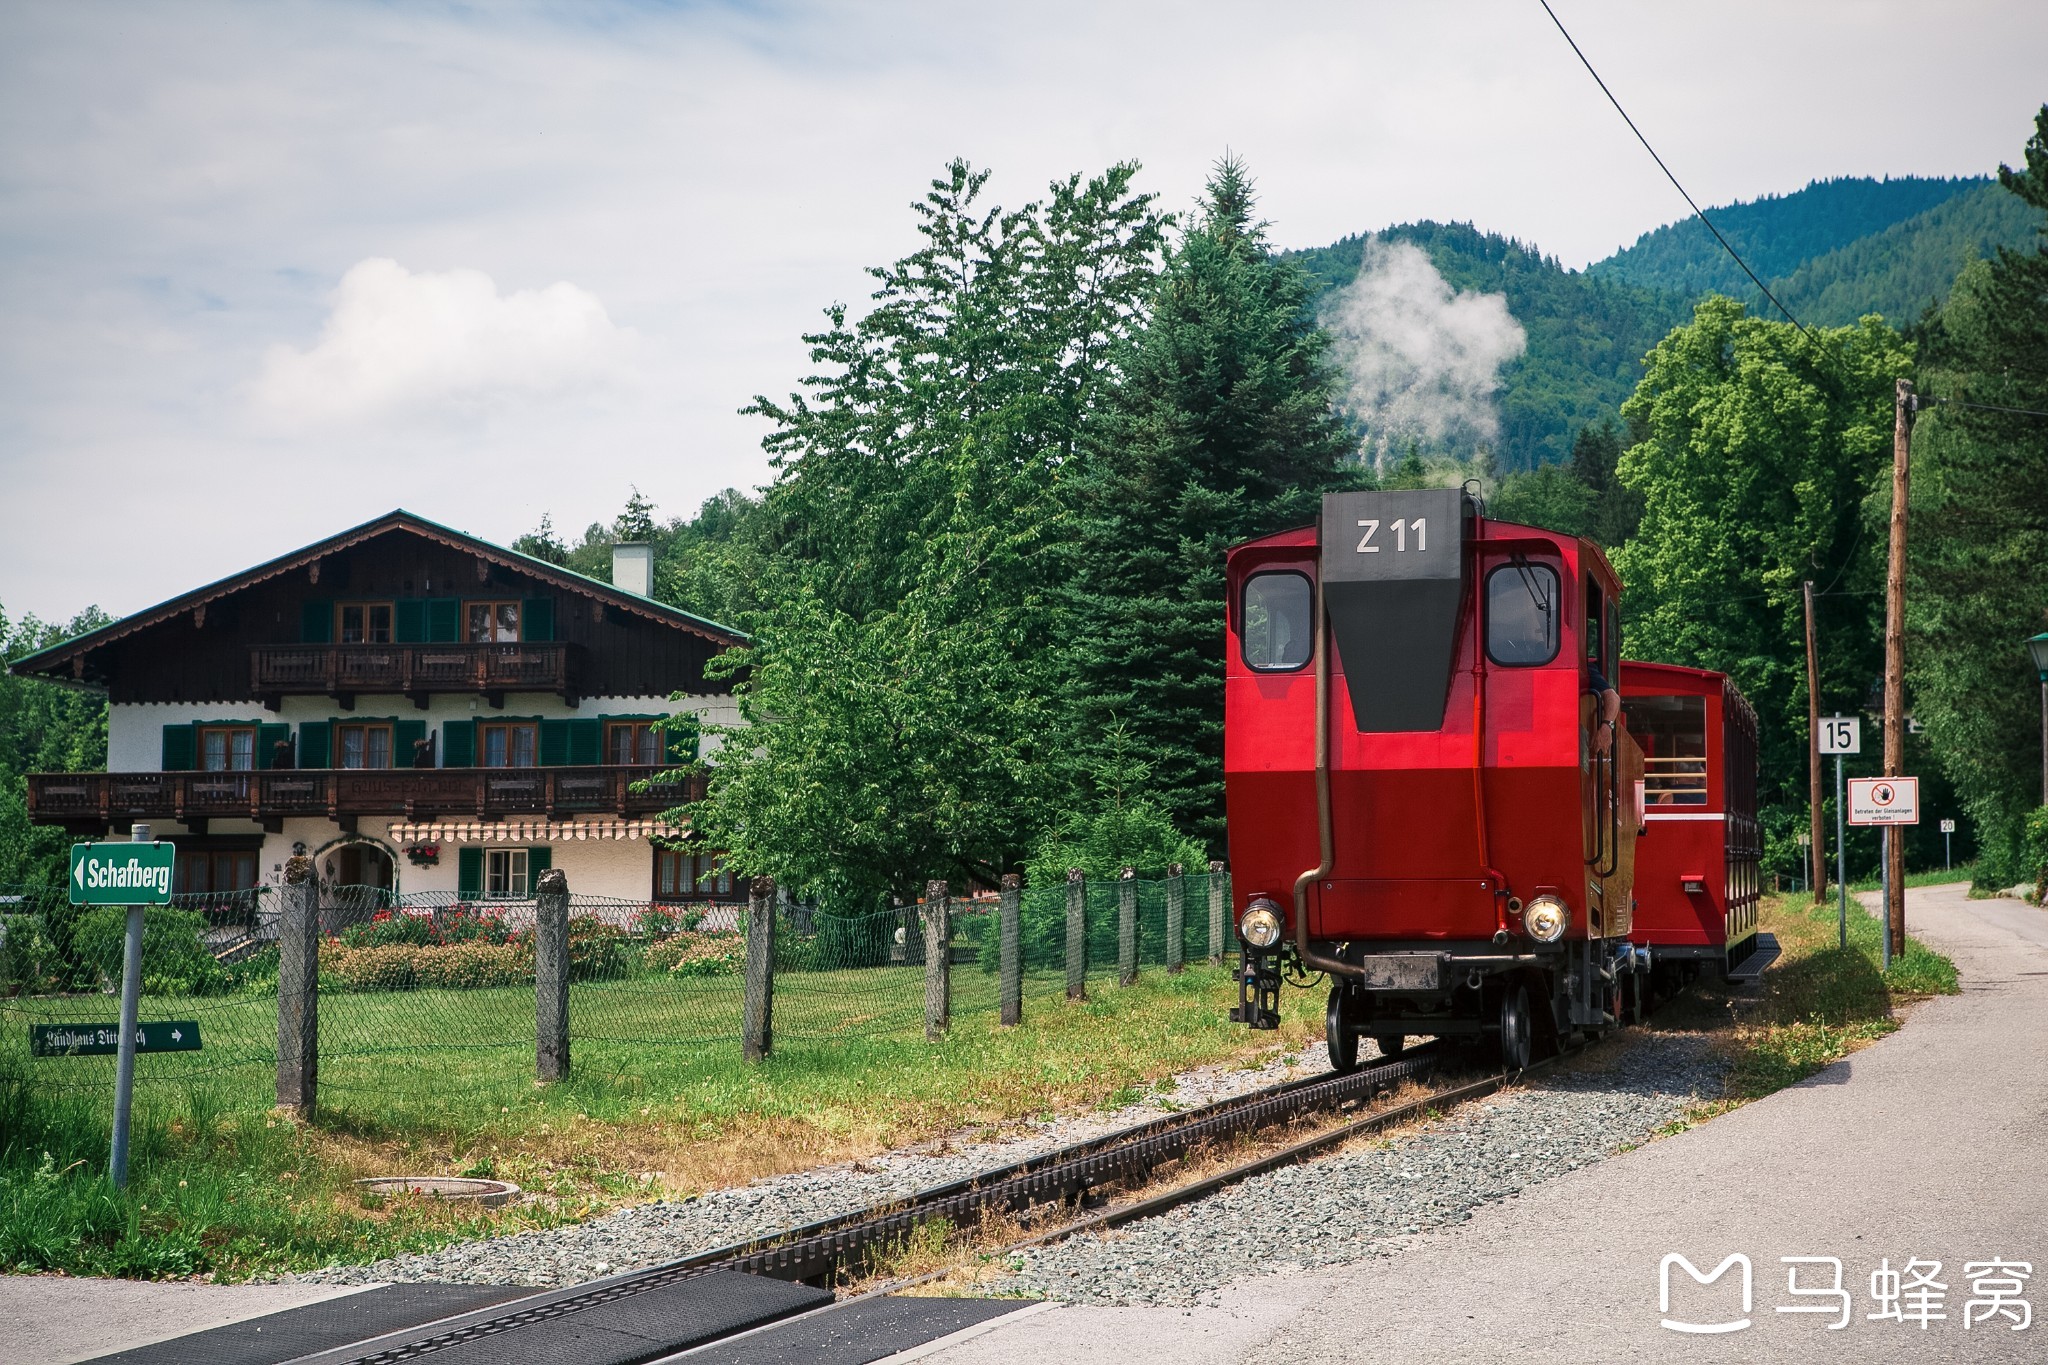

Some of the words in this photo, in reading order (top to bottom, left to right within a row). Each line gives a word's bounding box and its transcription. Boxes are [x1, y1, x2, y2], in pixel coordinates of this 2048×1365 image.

[1357, 519, 1380, 552] Z
[1389, 518, 1426, 551] 11
[1826, 722, 1852, 748] 15
[1943, 821, 1953, 830] 20
[87, 858, 170, 895] Schafberg
[46, 1030, 95, 1047] Landhaus
